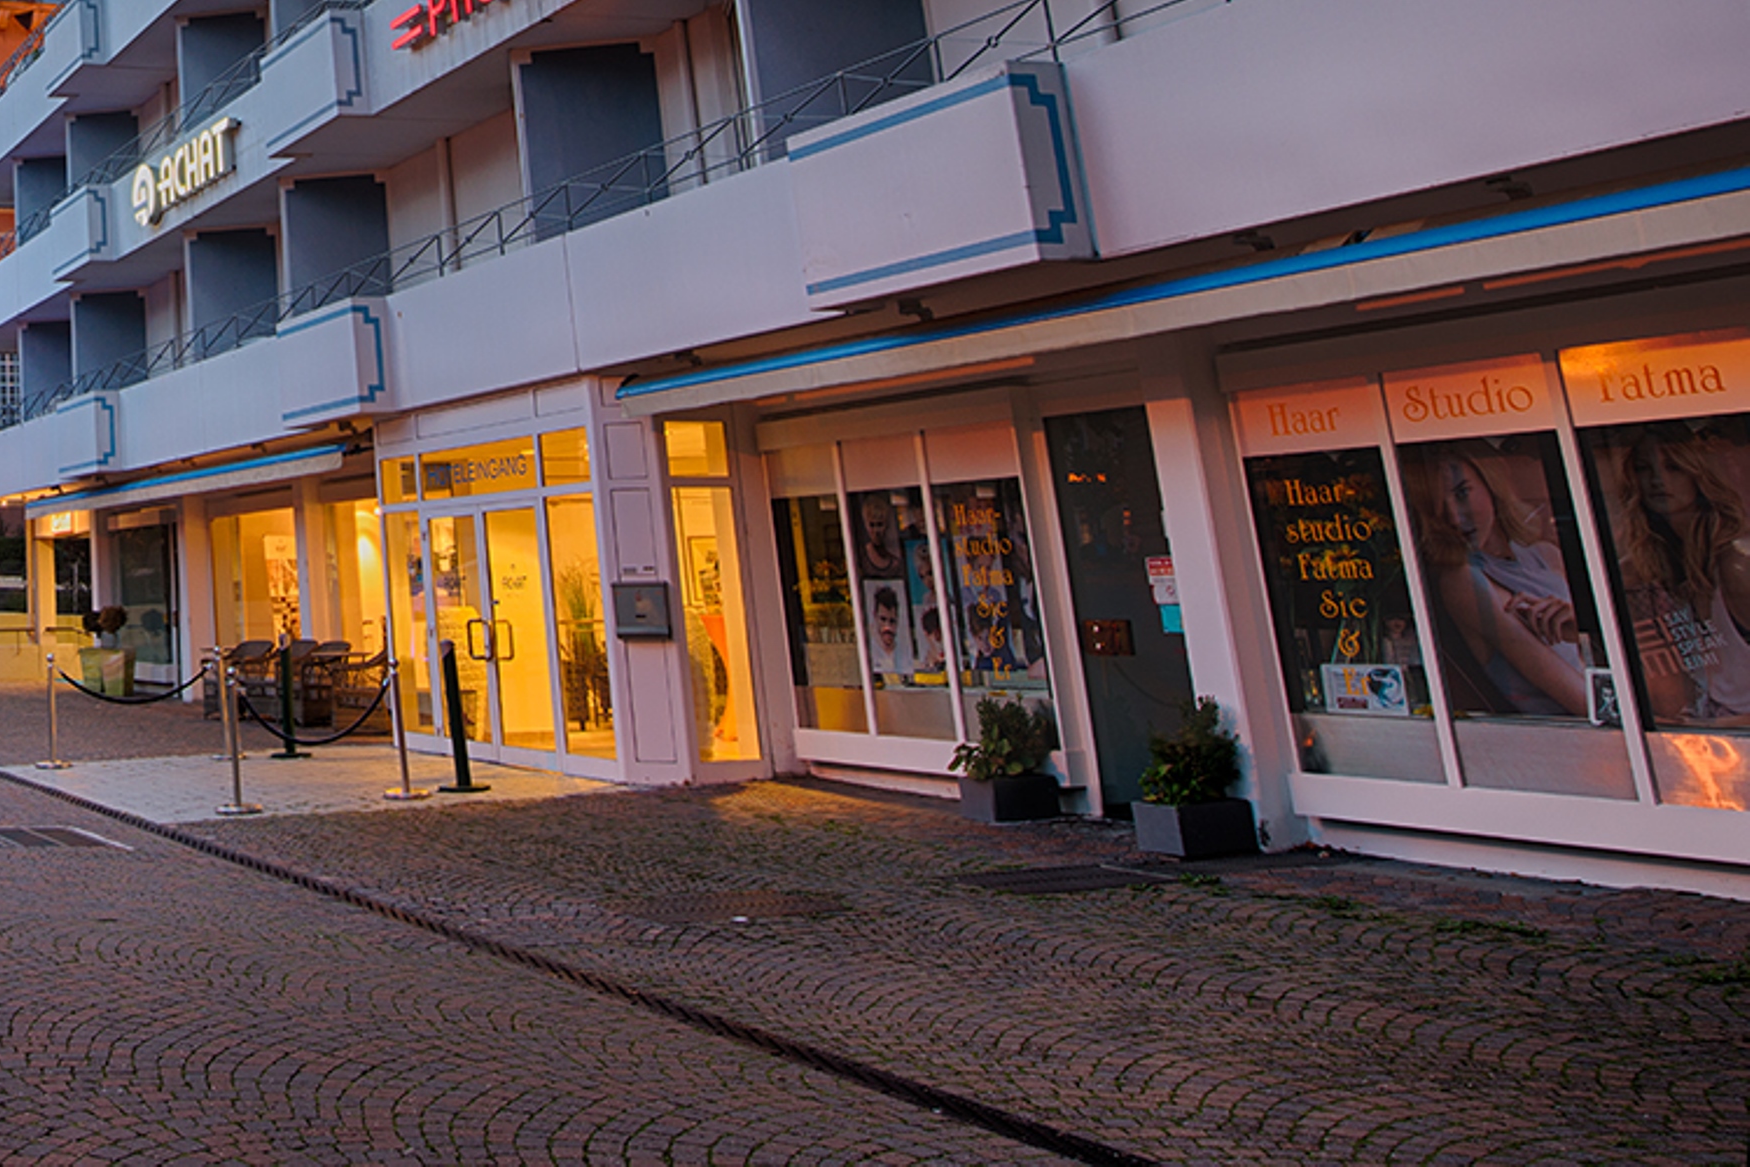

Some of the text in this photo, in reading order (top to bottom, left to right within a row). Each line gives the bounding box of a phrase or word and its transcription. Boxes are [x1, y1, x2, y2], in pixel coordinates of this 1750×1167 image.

[157, 116, 230, 209] ACHAT
[1267, 402, 1340, 437] Haar
[1403, 376, 1533, 422] Studio
[427, 454, 527, 487] HOTELEINGANG
[1284, 478, 1356, 506] Haar-
[953, 503, 1002, 526] Haar-
[1286, 513, 1372, 544] studio
[954, 533, 1013, 558] studio
[1298, 552, 1374, 581] Fatma
[1338, 629, 1361, 657] &
